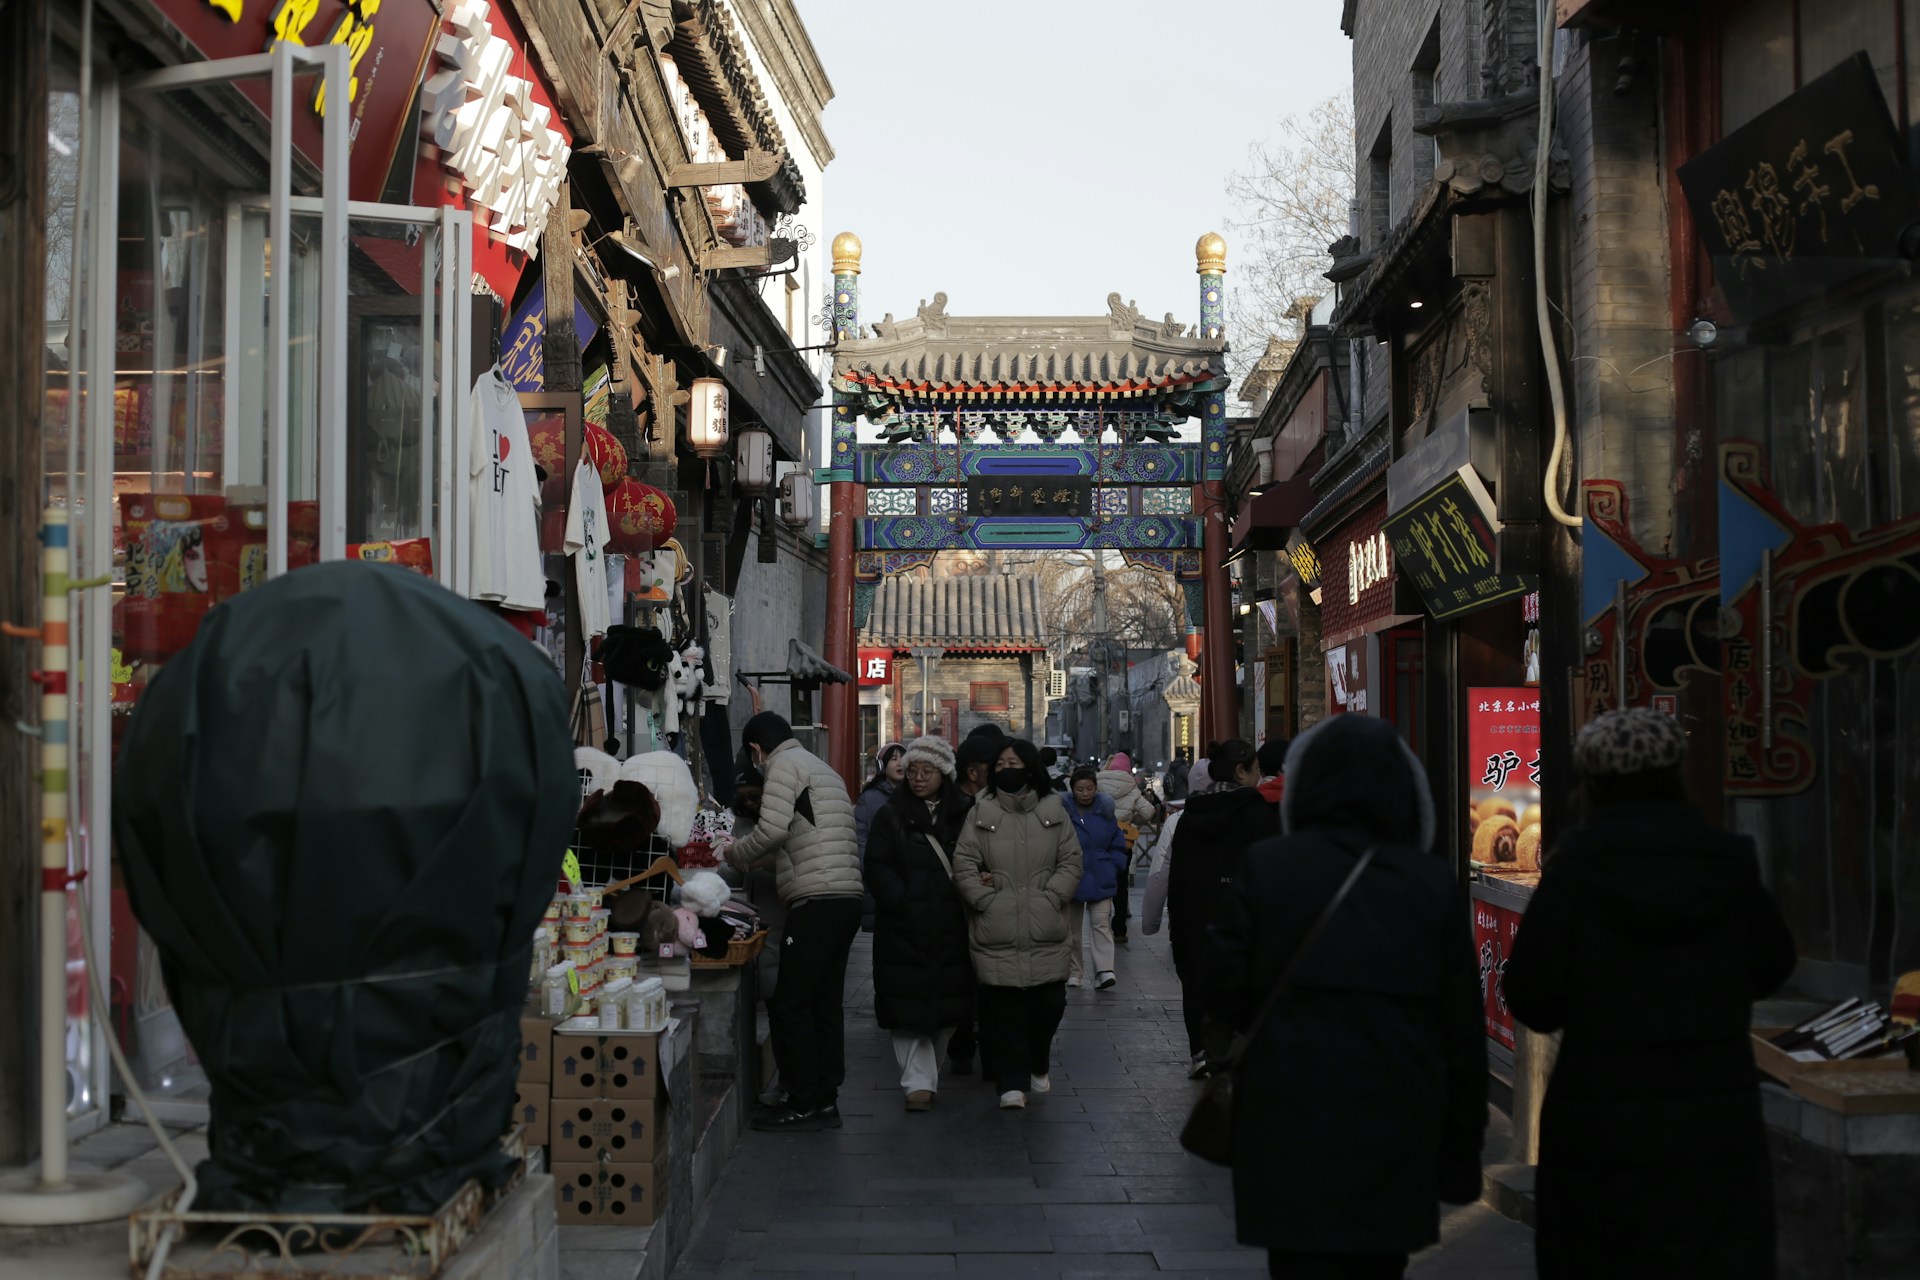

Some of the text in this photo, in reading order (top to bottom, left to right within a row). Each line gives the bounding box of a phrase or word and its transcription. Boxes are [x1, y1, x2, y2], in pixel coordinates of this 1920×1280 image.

[1408, 496, 1490, 584] 驴打滚
[1478, 700, 1540, 712] 北京名小吃
